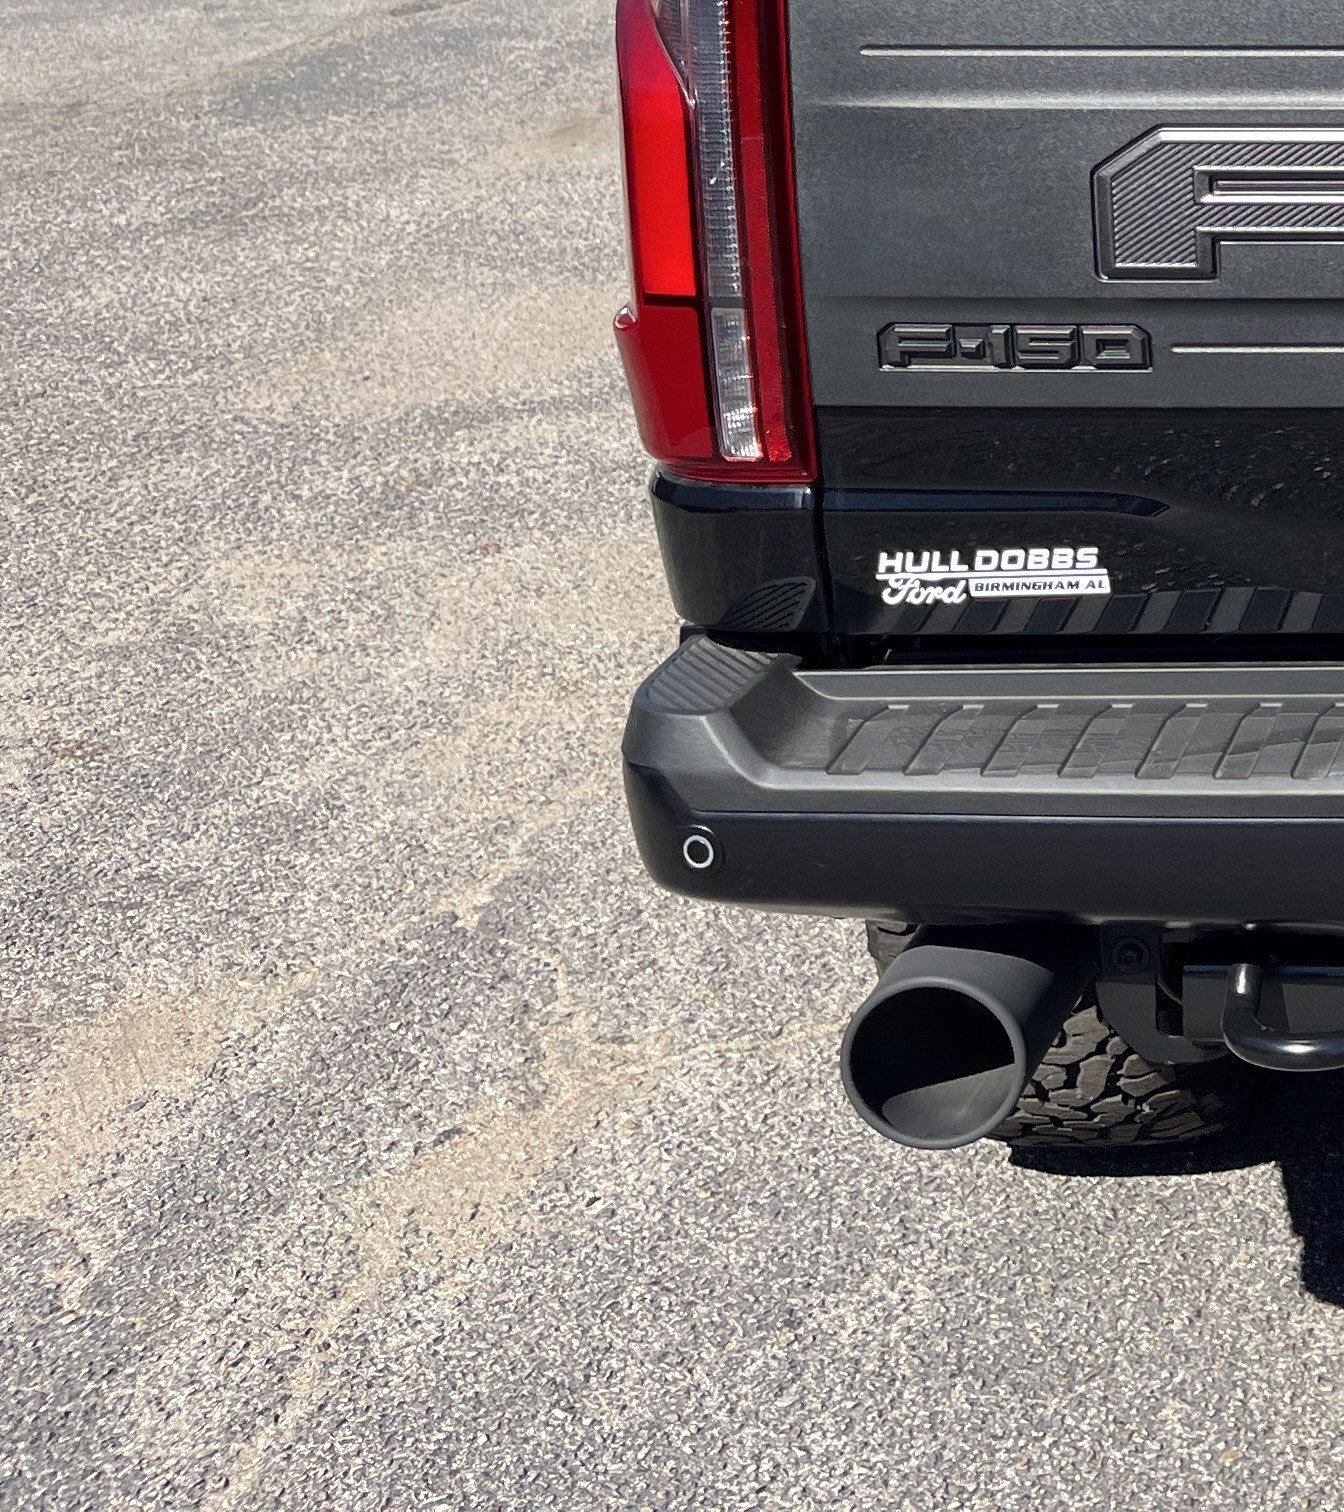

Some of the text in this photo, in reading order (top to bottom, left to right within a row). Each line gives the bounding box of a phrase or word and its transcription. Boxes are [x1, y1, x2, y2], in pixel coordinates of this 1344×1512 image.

[876, 322, 1153, 372] F-150
[878, 547, 1099, 573] HULL DOBBS
[882, 572, 1105, 605] Ford BIRMINGHAM AL
